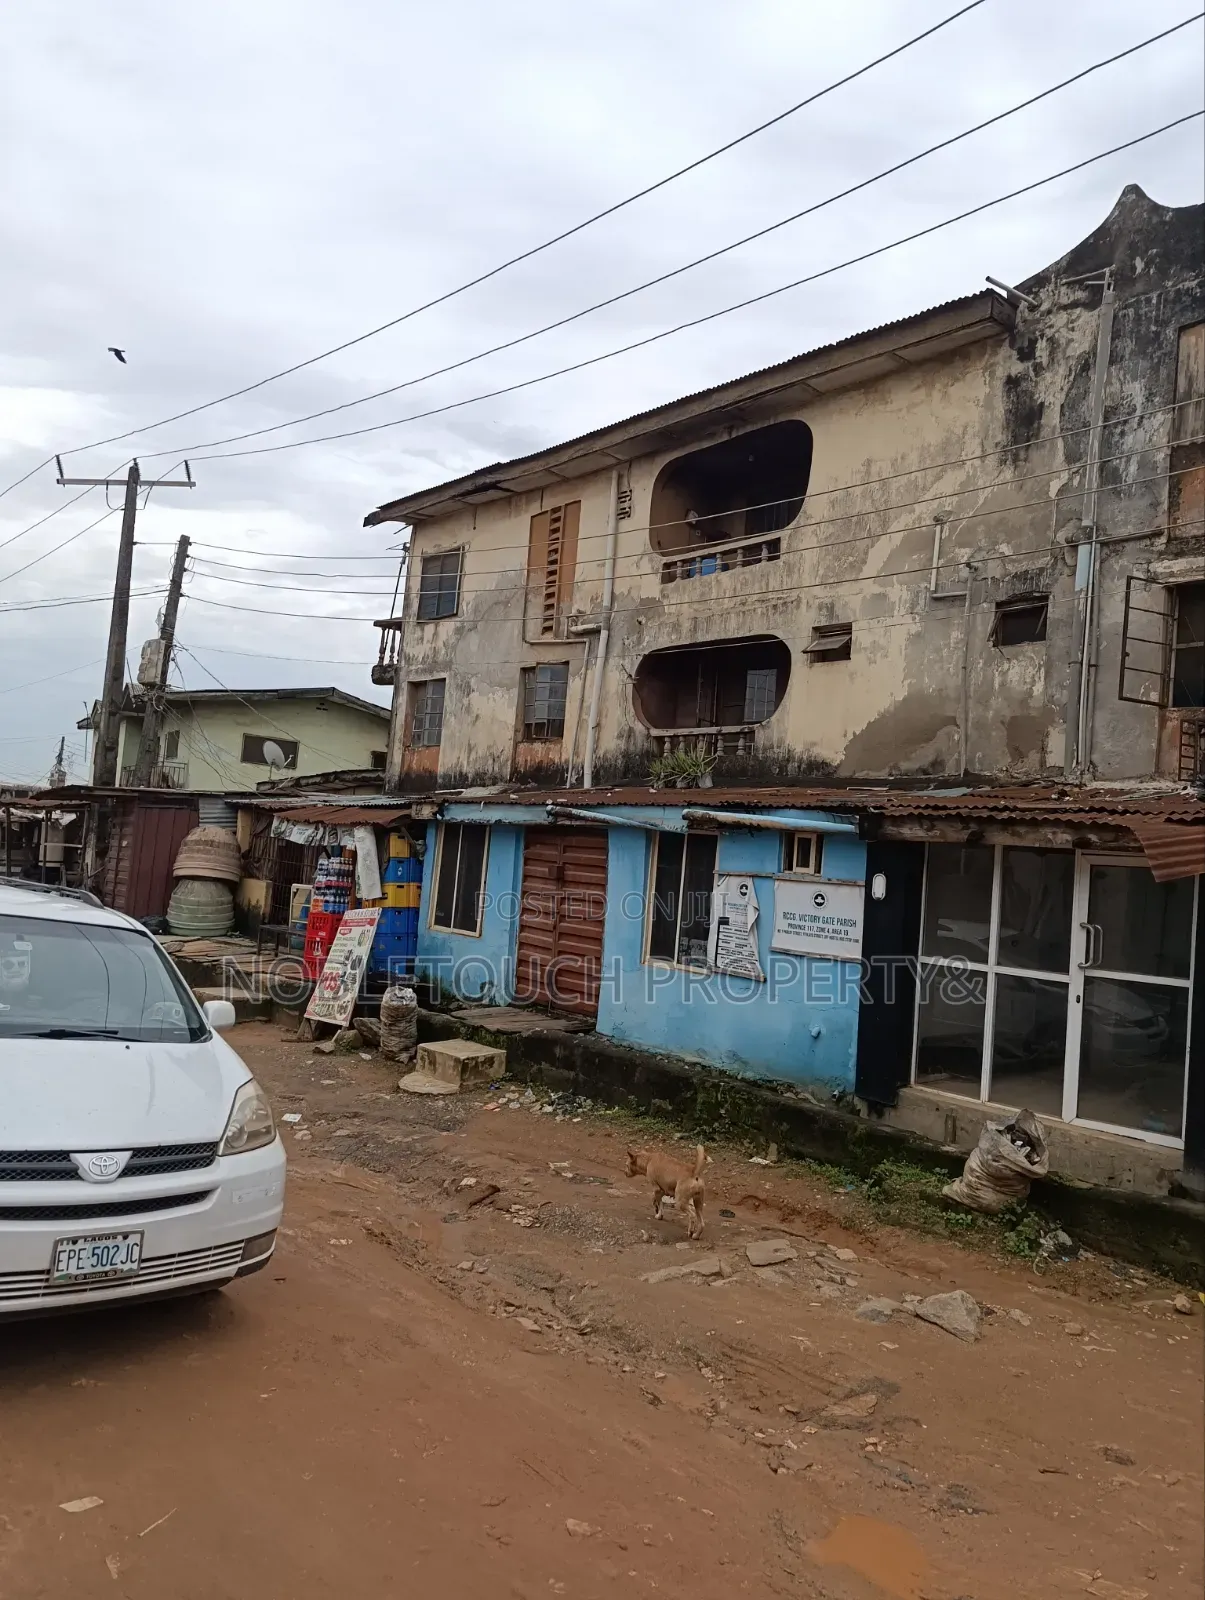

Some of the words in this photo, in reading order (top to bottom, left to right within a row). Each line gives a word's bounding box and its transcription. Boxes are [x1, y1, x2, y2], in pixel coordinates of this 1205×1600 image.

[798, 913, 821, 924] VICTORY
[821, 916, 835, 926] GATE
[836, 917, 857, 928] PARISH
